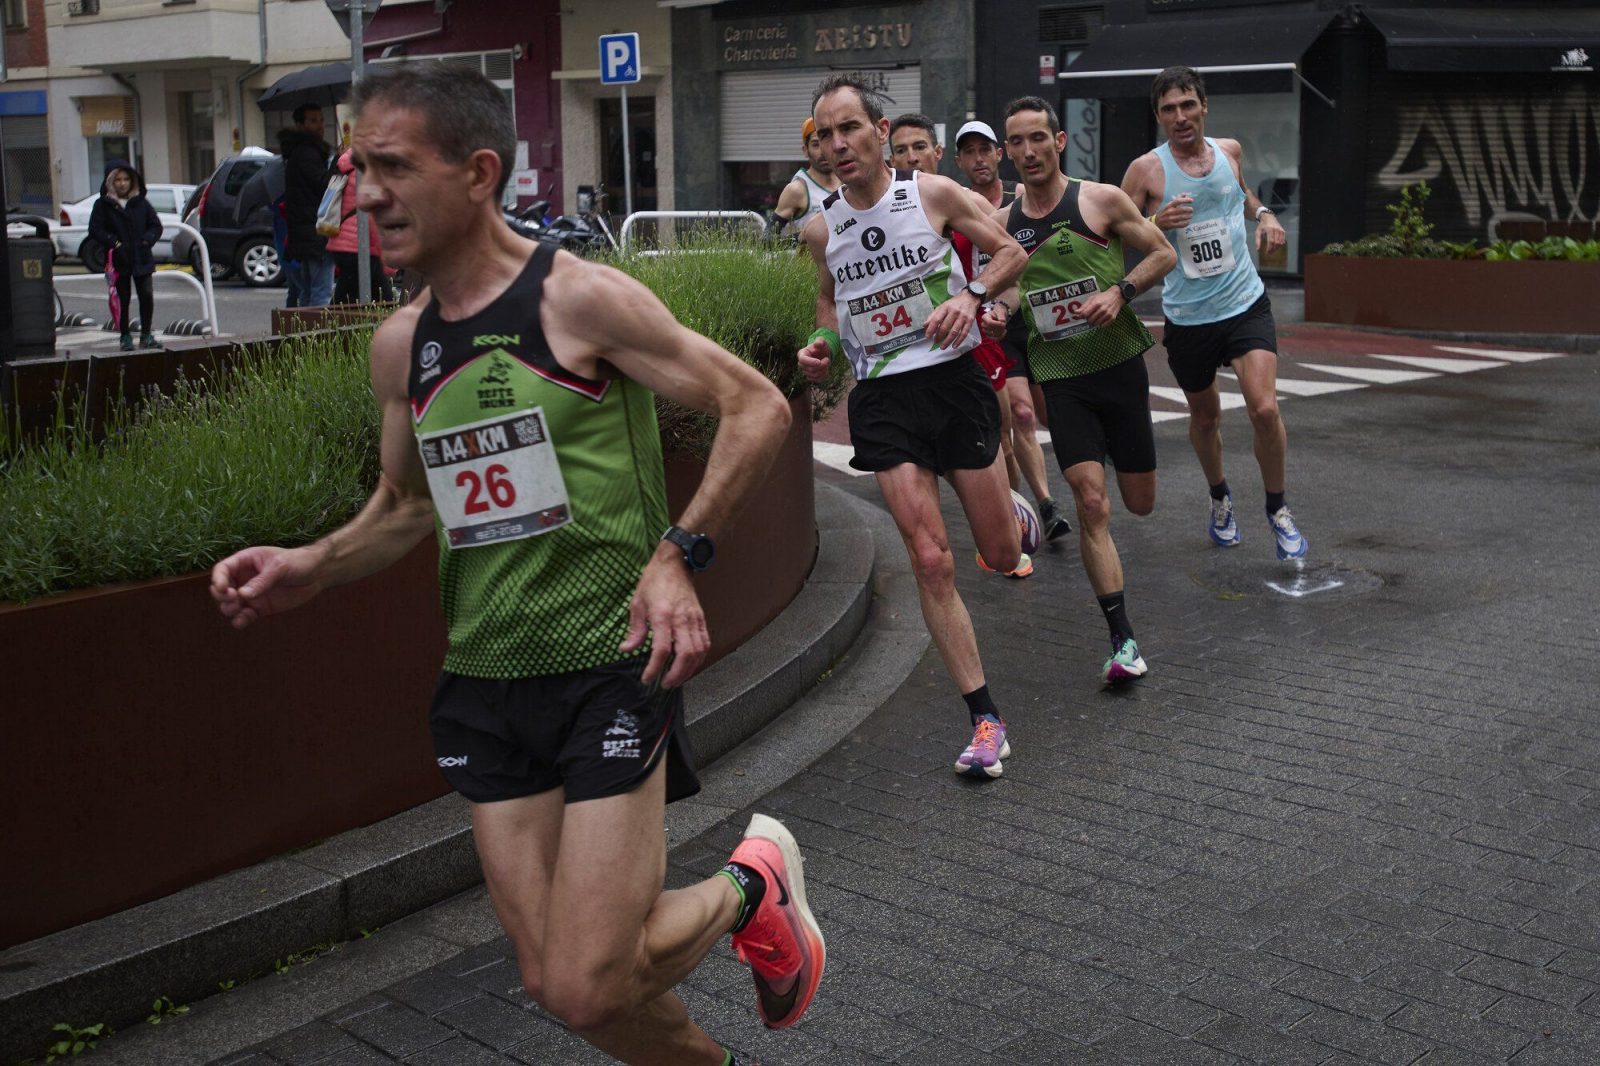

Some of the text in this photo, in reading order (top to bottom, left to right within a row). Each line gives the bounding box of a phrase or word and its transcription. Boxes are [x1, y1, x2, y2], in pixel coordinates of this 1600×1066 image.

[607, 41, 630, 78] P
[1191, 239, 1223, 264] 308
[863, 285, 906, 311] A4XKM
[1045, 283, 1081, 302] A4XKM
[871, 304, 913, 336] 34
[441, 425, 510, 463] A4XKM
[455, 463, 517, 516] 26
